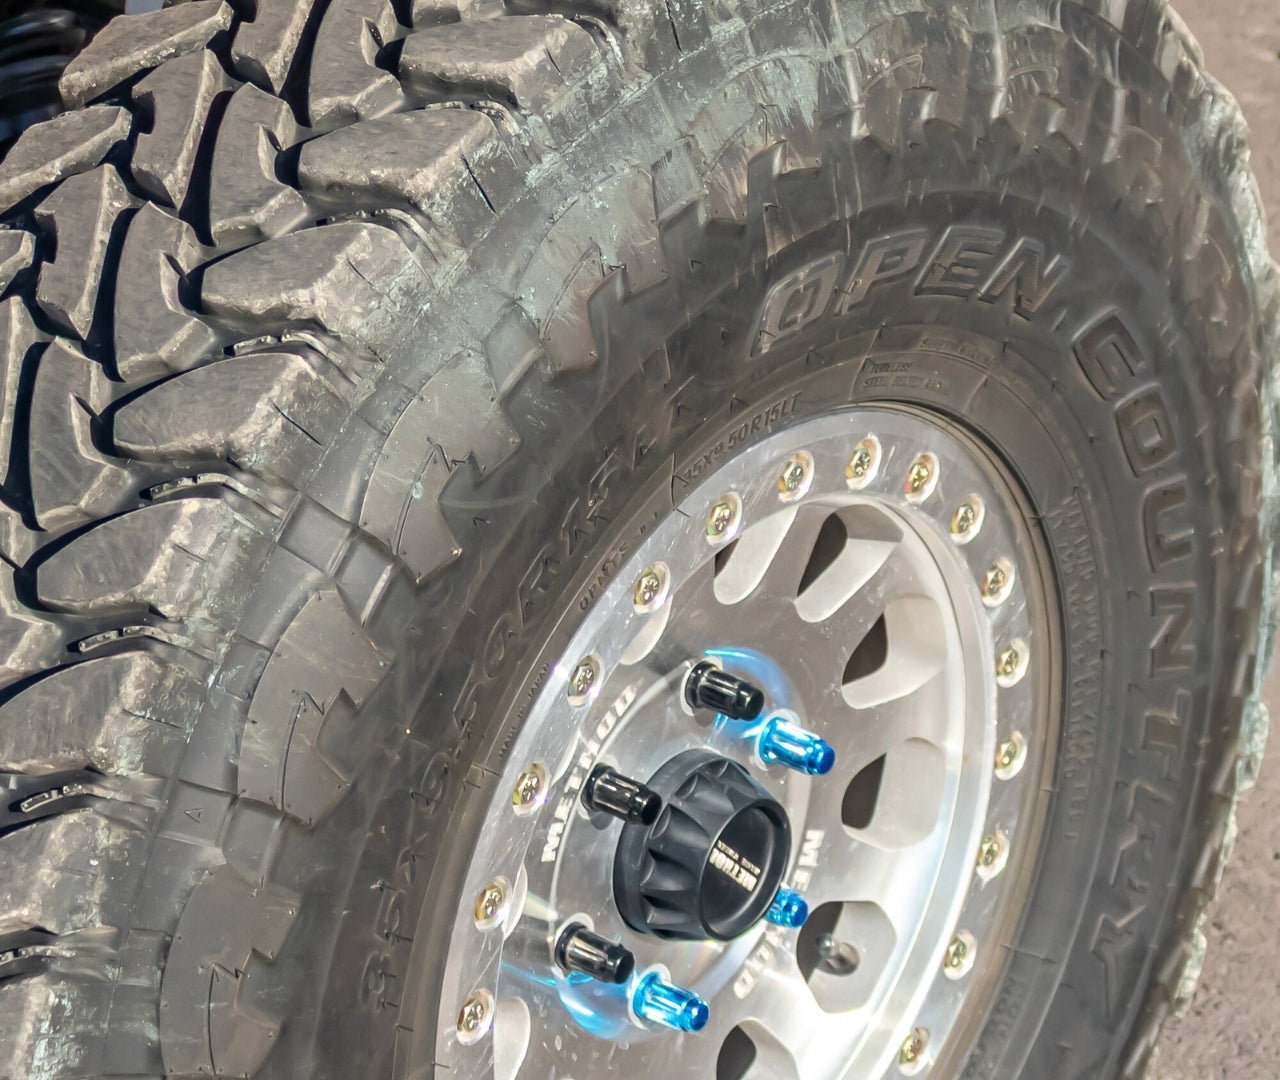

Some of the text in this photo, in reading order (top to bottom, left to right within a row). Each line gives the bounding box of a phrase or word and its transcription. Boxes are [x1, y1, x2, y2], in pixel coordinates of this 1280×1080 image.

[750, 224, 1196, 1018] OPEN COUNTRY
[541, 684, 638, 863] METHOD
[732, 829, 825, 999] MEHOD
